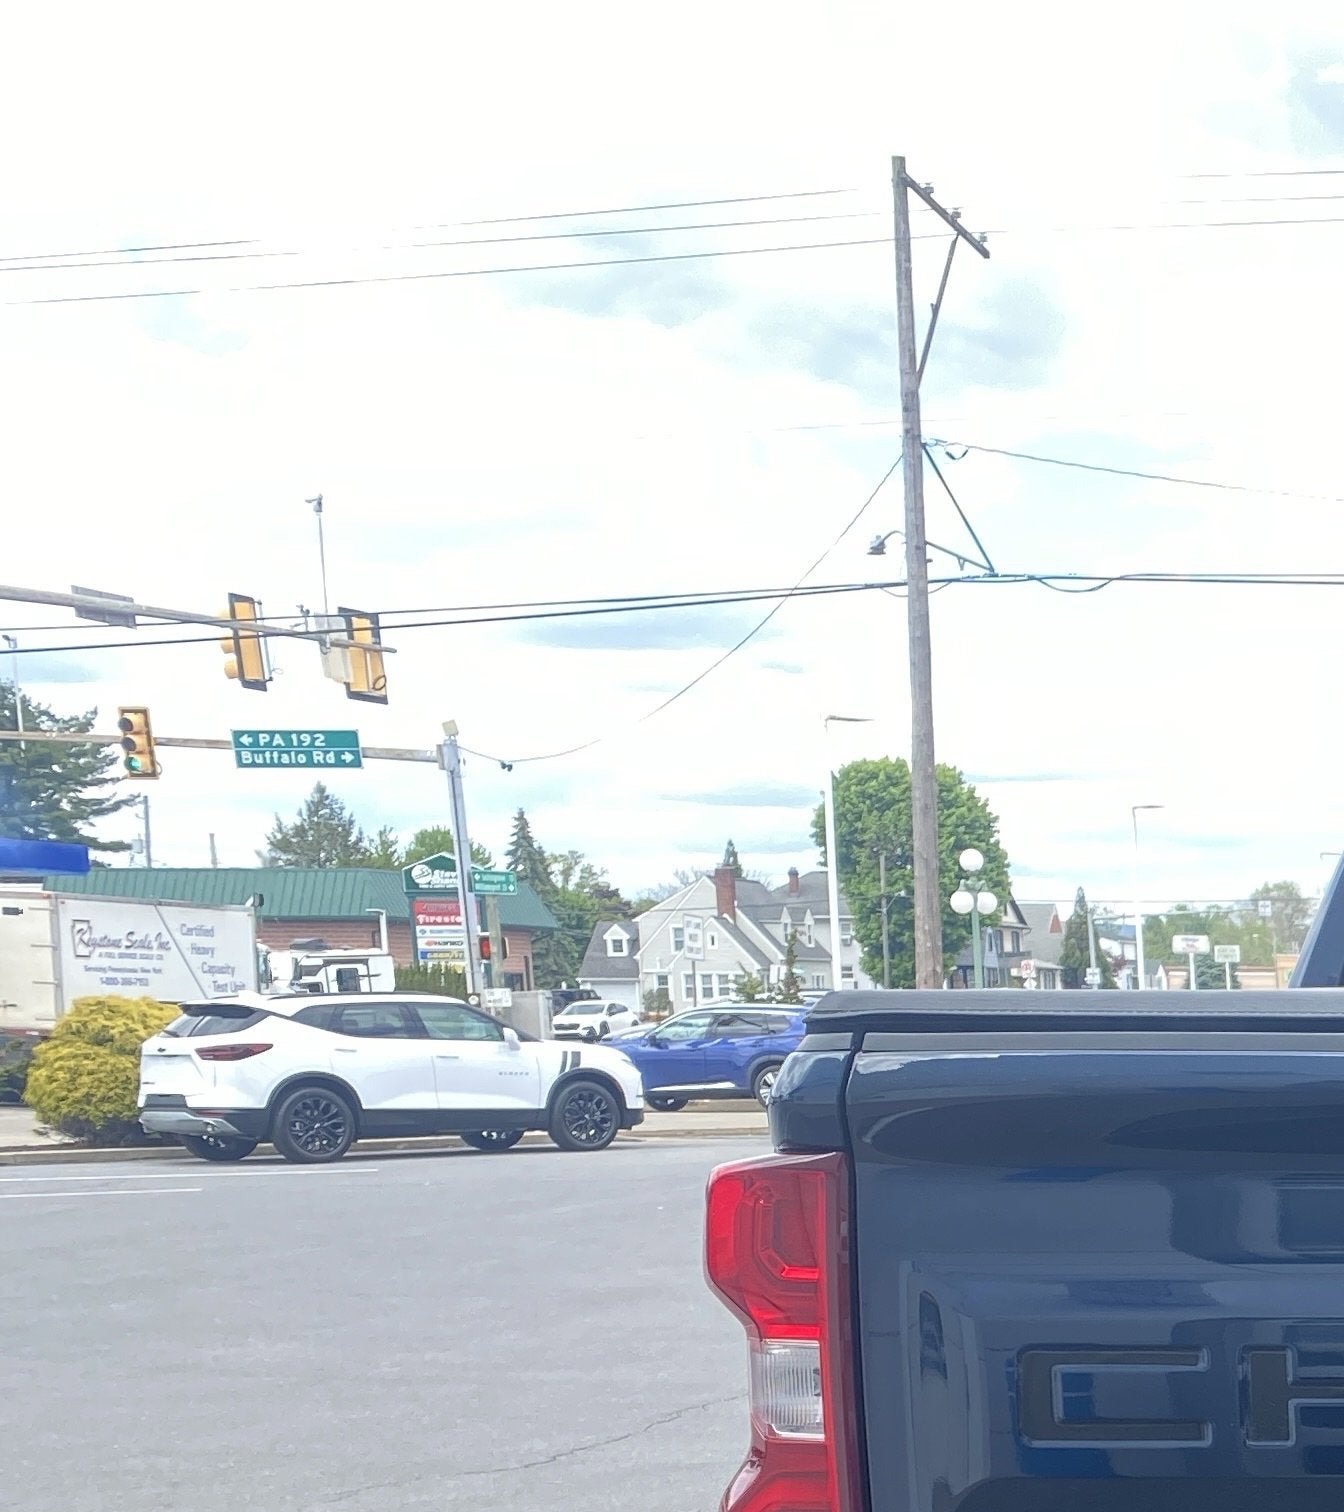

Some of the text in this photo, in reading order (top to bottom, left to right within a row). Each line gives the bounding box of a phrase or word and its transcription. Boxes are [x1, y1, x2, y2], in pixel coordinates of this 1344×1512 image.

[258, 733, 327, 747] PA 192
[240, 750, 335, 764] Buffalo Rd
[416, 914, 464, 924] Firesto
